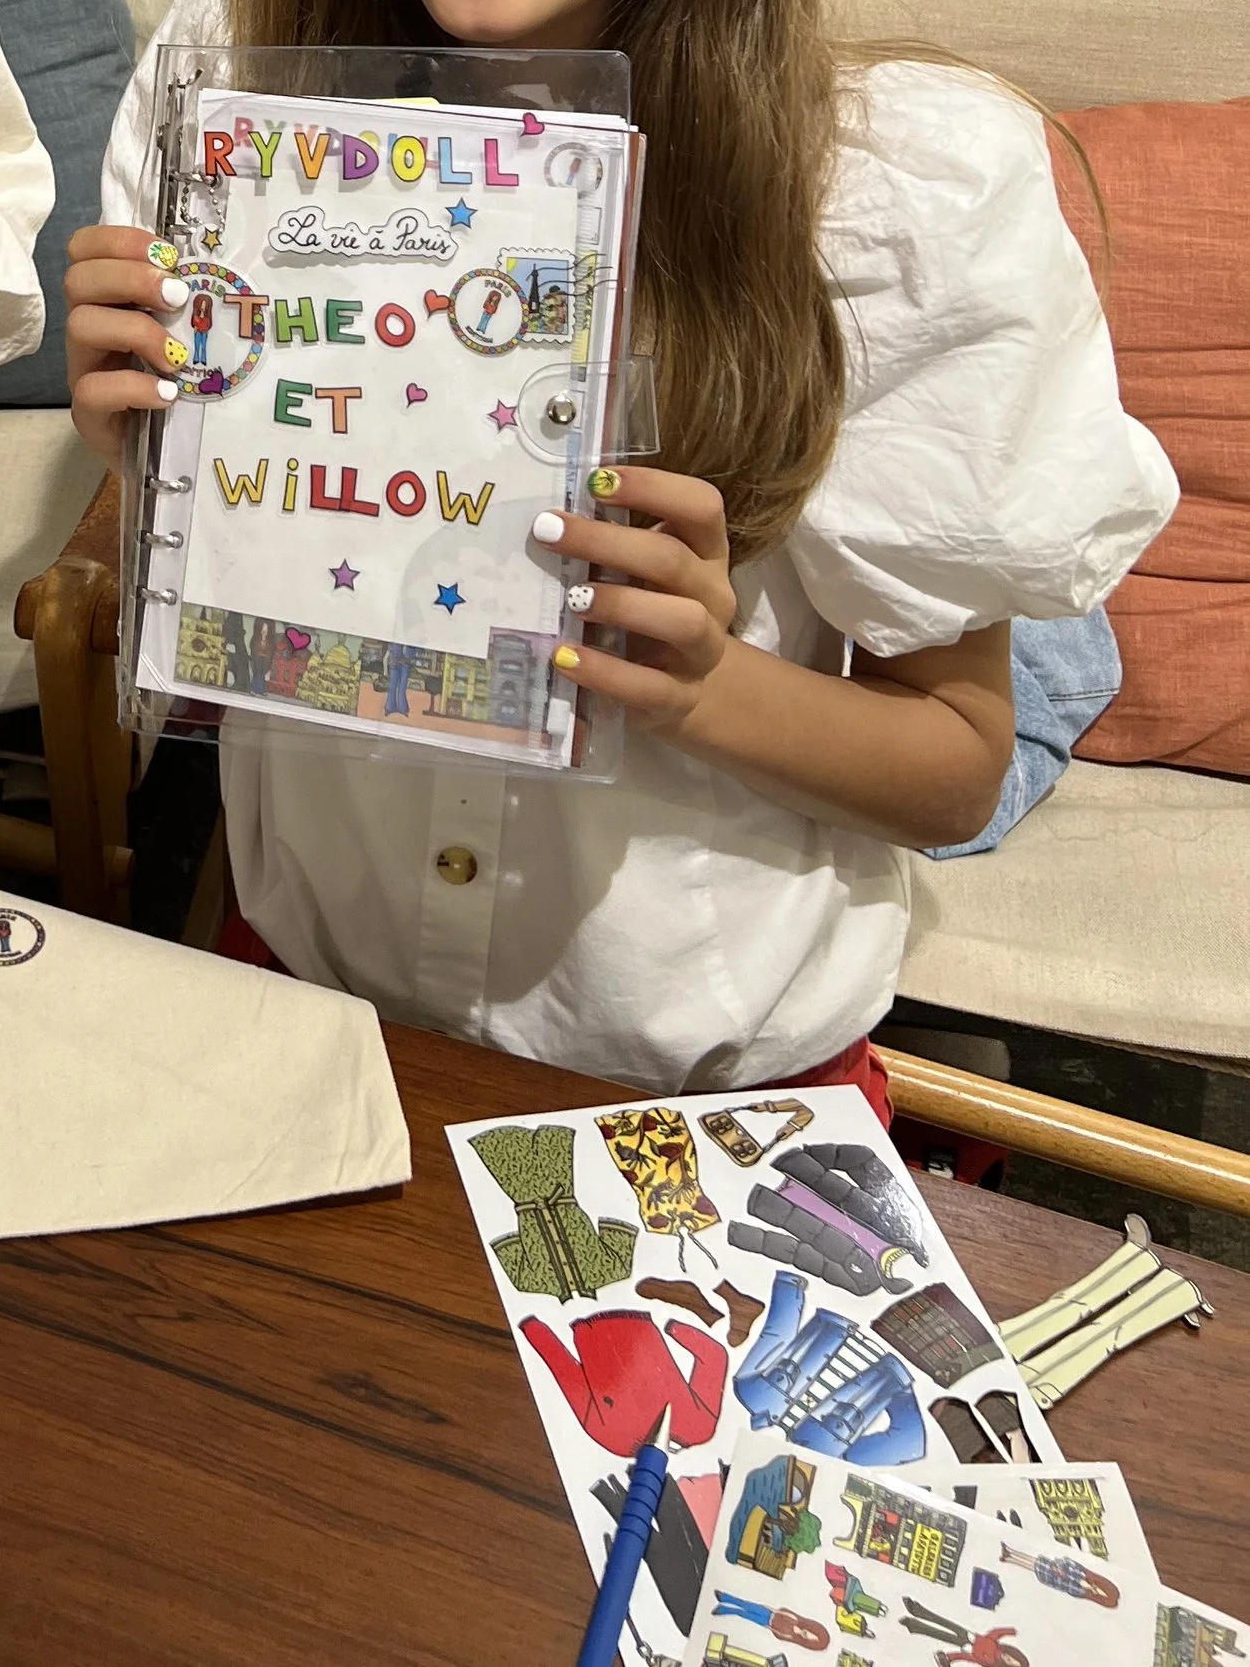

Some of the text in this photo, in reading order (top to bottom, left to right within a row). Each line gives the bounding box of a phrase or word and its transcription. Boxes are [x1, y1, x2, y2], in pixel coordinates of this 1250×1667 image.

[203, 131, 520, 186] RYVDOLL
[278, 213, 321, 250] La
[330, 228, 358, 250] vie
[393, 215, 451, 254] Paris
[186, 279, 226, 298] ARIS
[223, 293, 417, 348] THEO
[273, 379, 363, 435] ET
